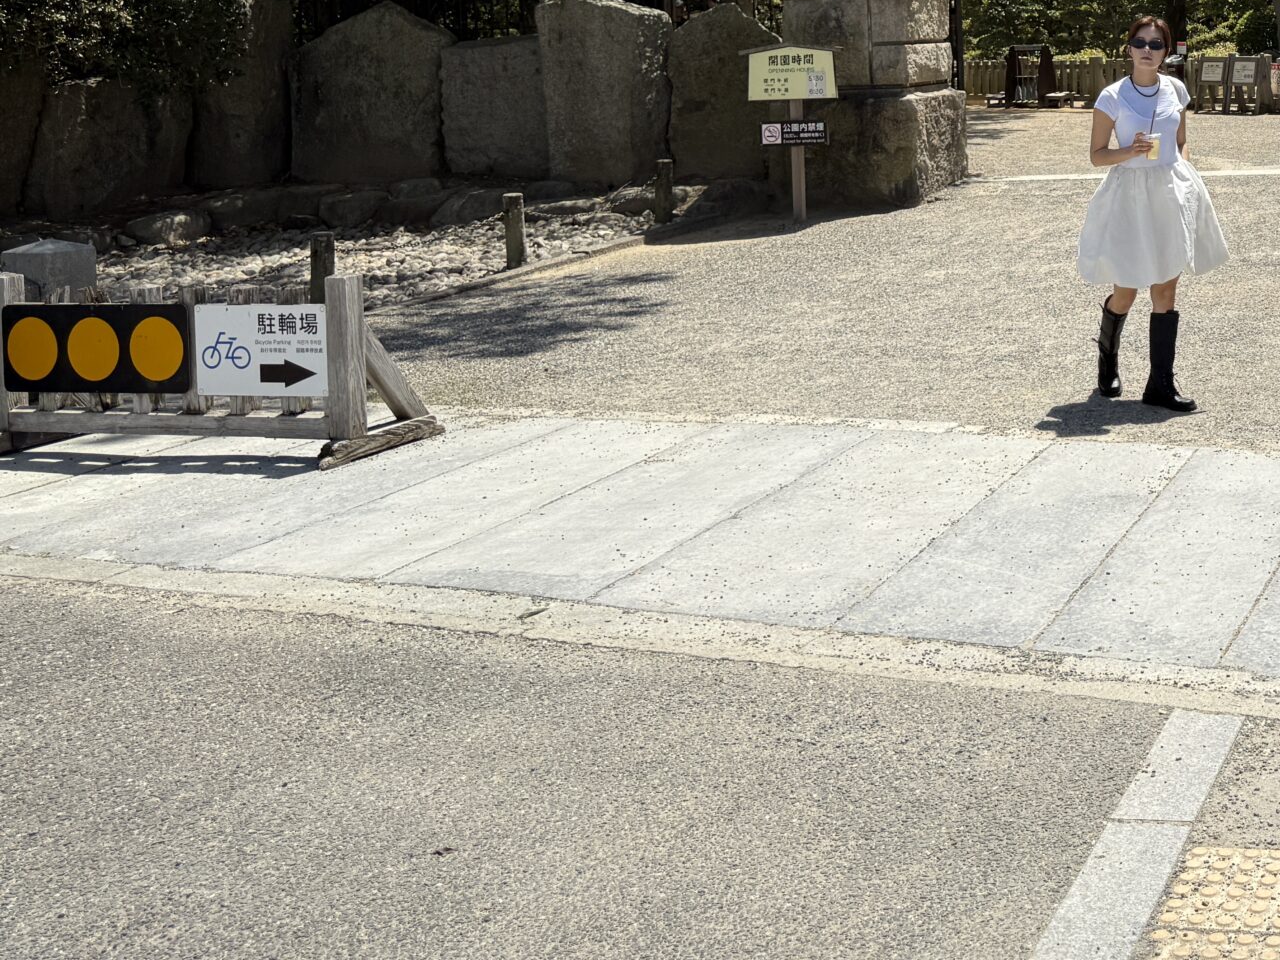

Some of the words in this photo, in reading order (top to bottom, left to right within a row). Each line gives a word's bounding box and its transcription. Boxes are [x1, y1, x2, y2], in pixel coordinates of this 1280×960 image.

[768, 54, 814, 66] 開園時間
[783, 123, 825, 132] 公園内禁煙
[257, 312, 318, 335] 駐輪場
